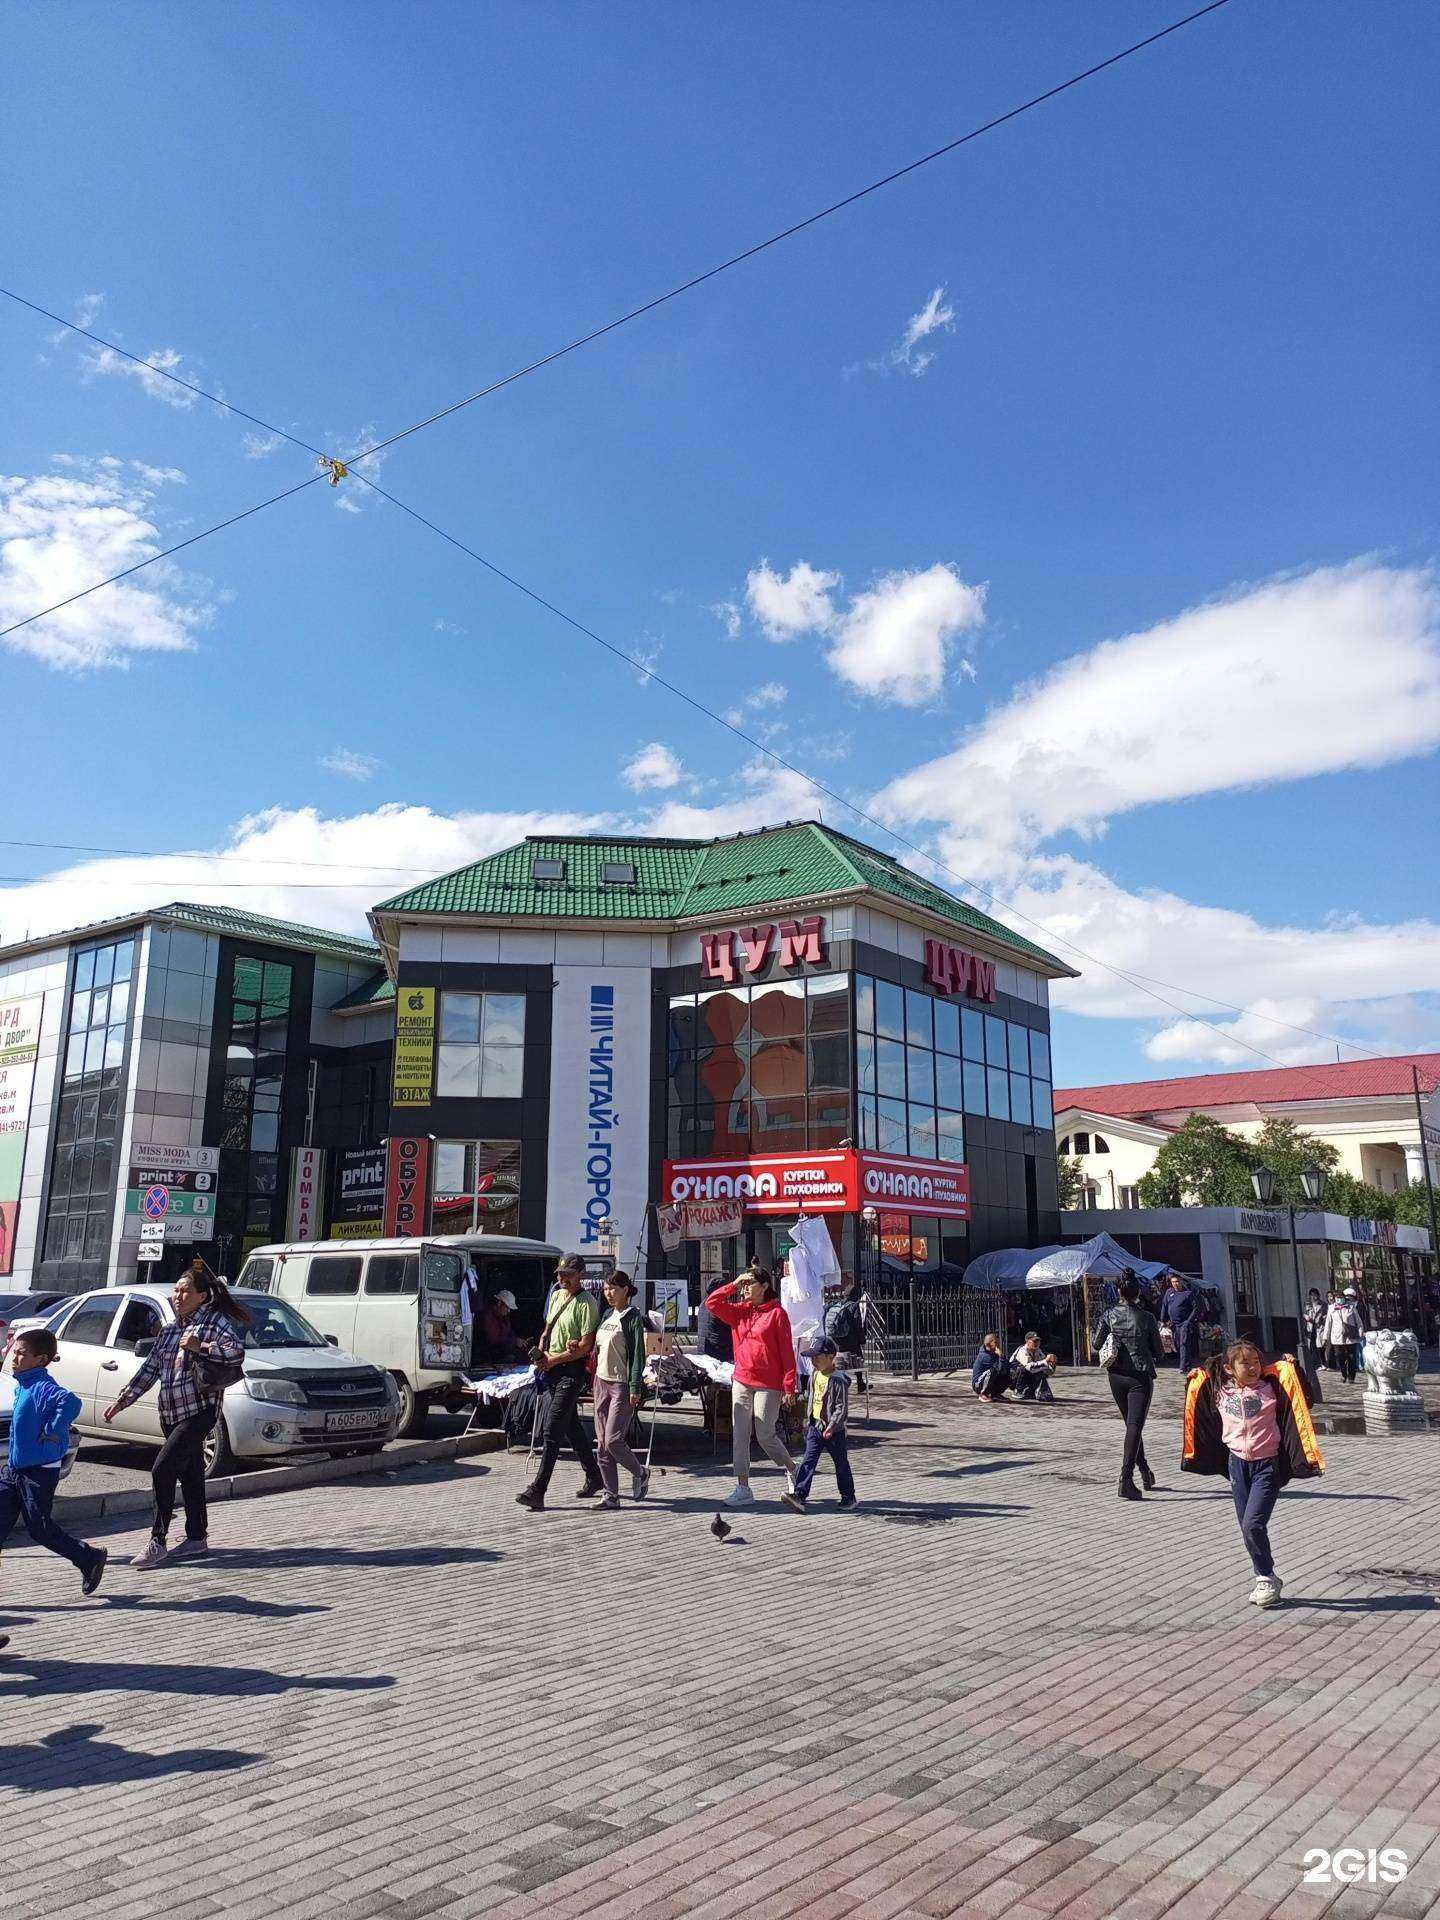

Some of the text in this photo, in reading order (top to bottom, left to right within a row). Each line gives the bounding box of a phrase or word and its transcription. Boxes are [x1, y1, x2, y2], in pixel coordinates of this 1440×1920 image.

[700, 915, 825, 983] ЦУМ
[926, 939, 996, 1003] ЦУМ
[0, 1006, 20, 1028] РД
[399, 1016, 432, 1027] РЕМОНТ
[399, 1037, 432, 1047] ТЕХНИКИ
[402, 1088, 430, 1101] ЭТАЖ
[580, 1036, 619, 1244] ЧИТАЙ-ГОРОД
[138, 1145, 191, 1158] MISS MODA
[366, 1148, 387, 1157] магази
[139, 1170, 175, 1183] print
[342, 1161, 384, 1190] print
[671, 1172, 777, 1201] O'HARA
[783, 1169, 826, 1182] КУРТКИ
[864, 1169, 933, 1199] O'HARA
[298, 1151, 314, 1240] ЛОМБАР
[395, 1140, 420, 1237] ОБУВЬ
[783, 1182, 844, 1196] ПУХОВИКИ
